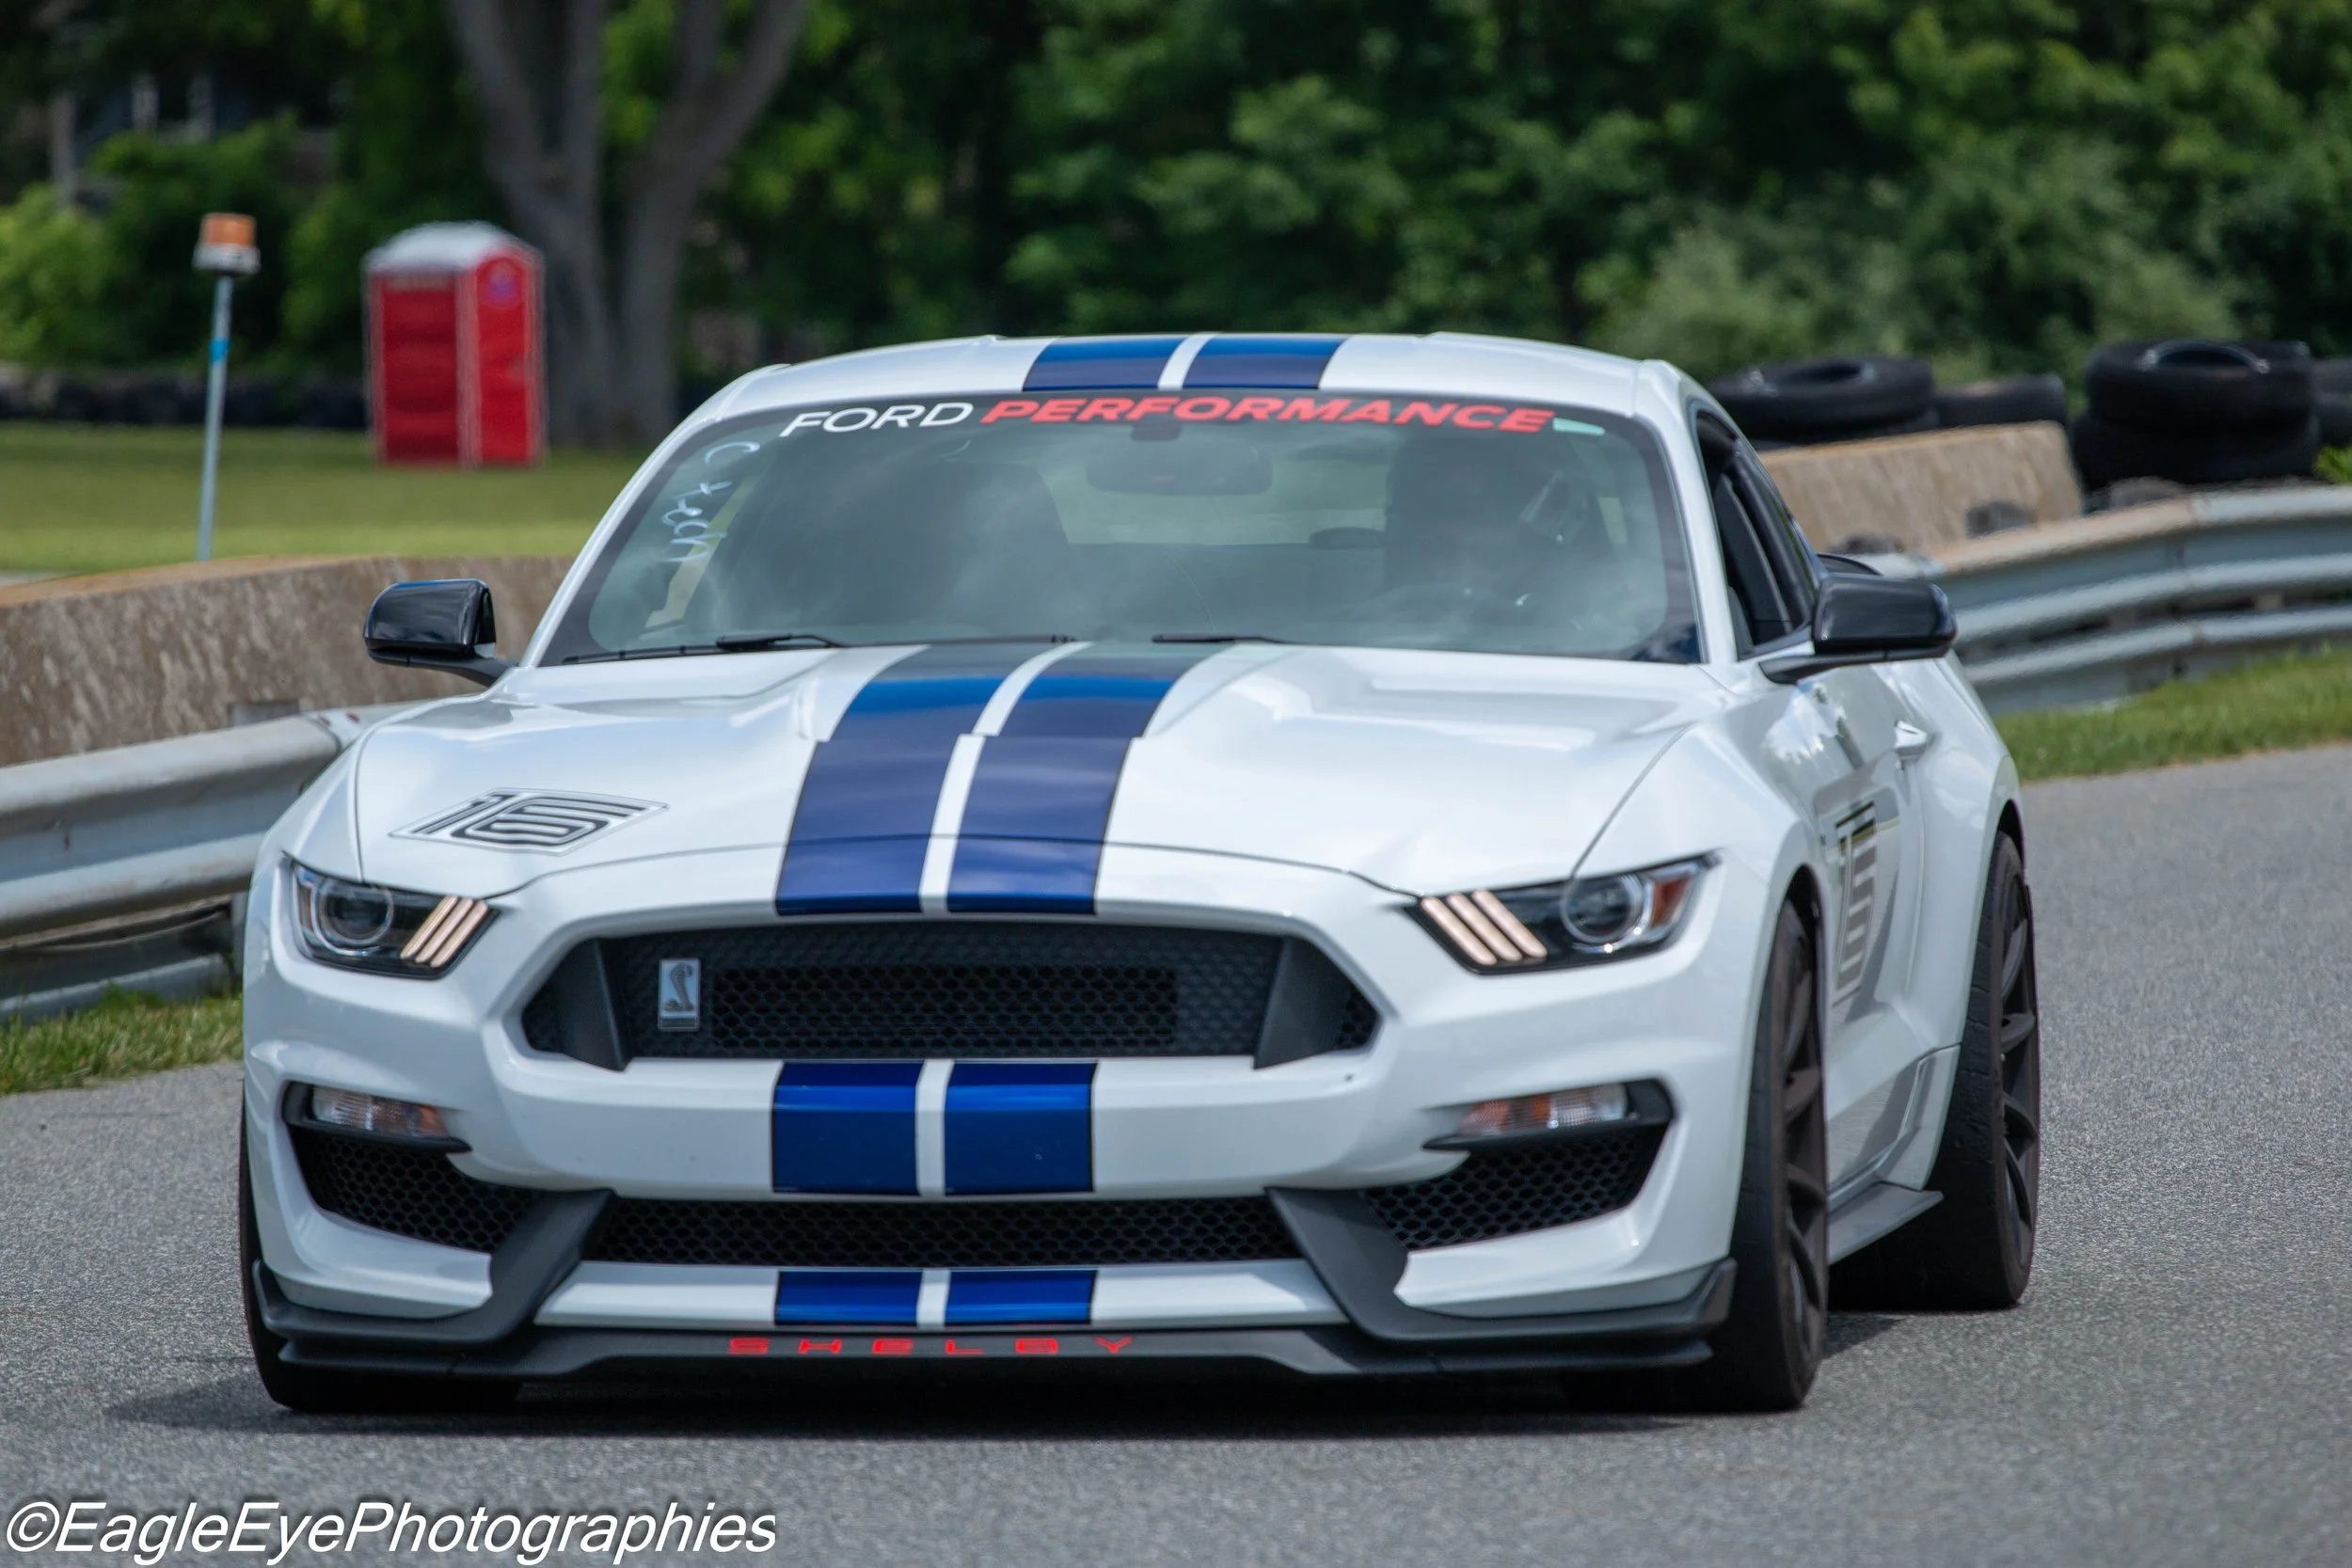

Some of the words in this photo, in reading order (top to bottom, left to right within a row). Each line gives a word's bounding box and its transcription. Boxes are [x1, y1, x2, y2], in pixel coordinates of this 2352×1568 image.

[778, 402, 975, 437] FORD
[979, 396, 1556, 434] PERFORMANCE
[410, 794, 648, 847] 16
[727, 1336, 1134, 1355] SHELBY
